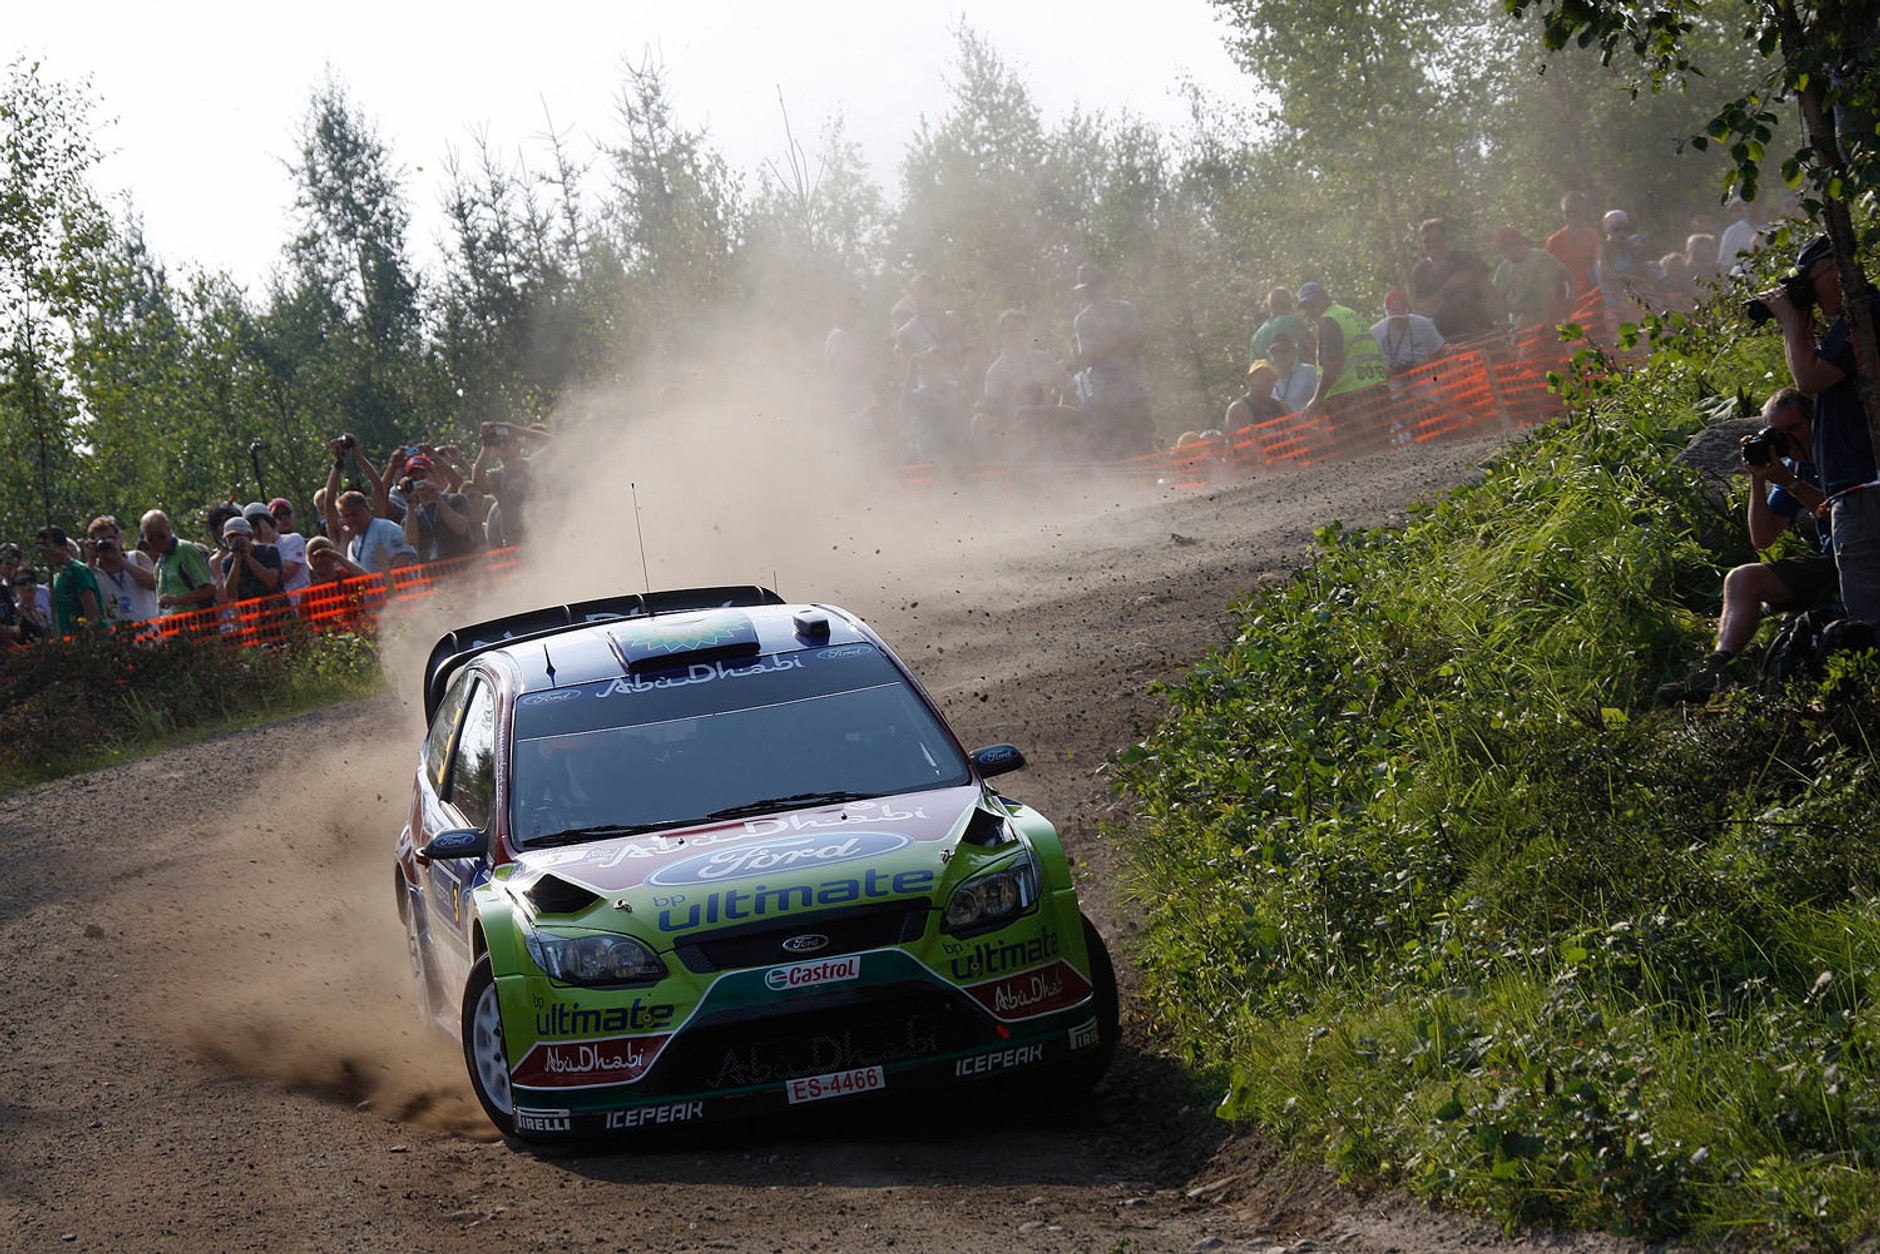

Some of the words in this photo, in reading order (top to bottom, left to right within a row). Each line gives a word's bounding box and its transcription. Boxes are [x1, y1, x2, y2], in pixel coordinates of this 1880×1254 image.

[697, 836, 862, 878] Ford
[652, 893, 687, 908] bp
[658, 868, 934, 932] ultimate
[943, 942, 963, 956] bp
[789, 959, 855, 985] Castrol
[536, 998, 675, 1036] ultimate
[955, 1044, 1043, 1077] ICEPEAK
[793, 1068, 879, 1101] ES-4466
[514, 1106, 571, 1131] PIRELLI
[605, 1101, 704, 1130] ICEPEAK
